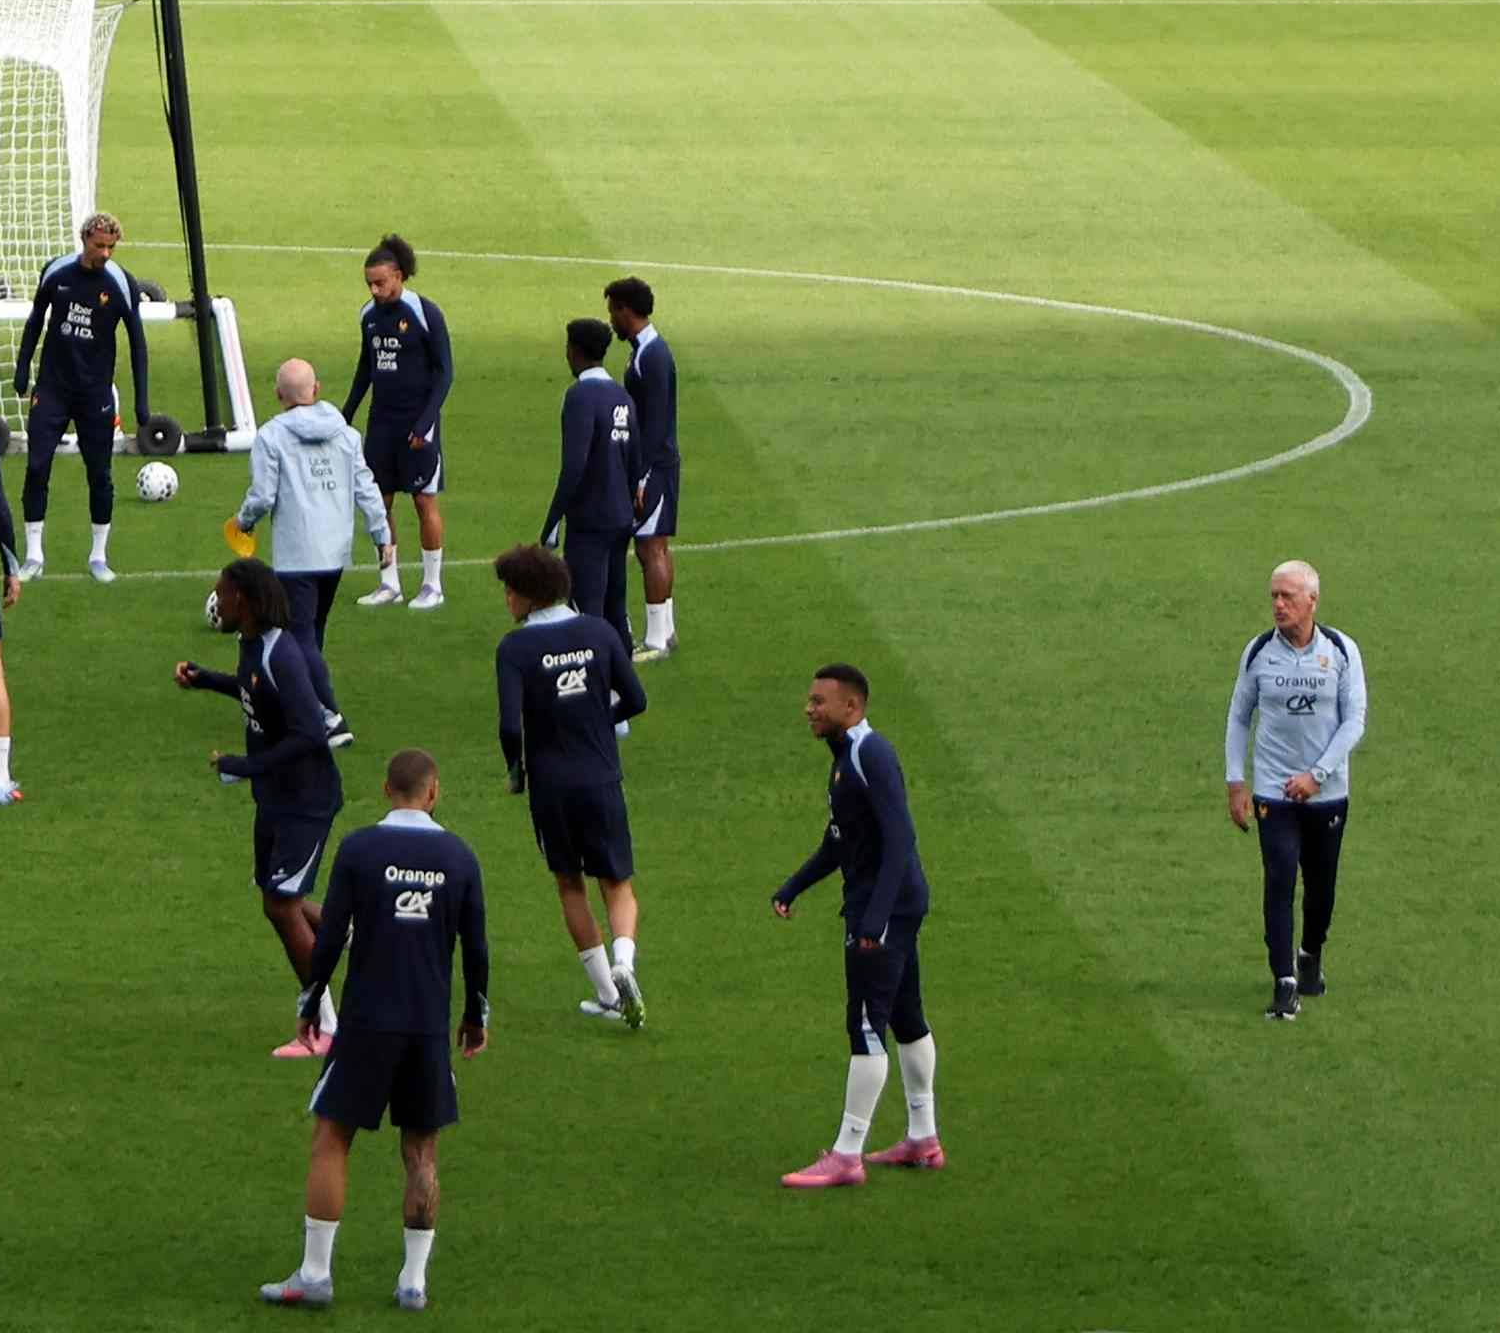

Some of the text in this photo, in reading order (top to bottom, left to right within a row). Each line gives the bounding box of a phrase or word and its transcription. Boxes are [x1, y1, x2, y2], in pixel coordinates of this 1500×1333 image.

[542, 649, 594, 668] Orange
[1275, 675, 1327, 690] Orange
[385, 865, 446, 887] Orange
